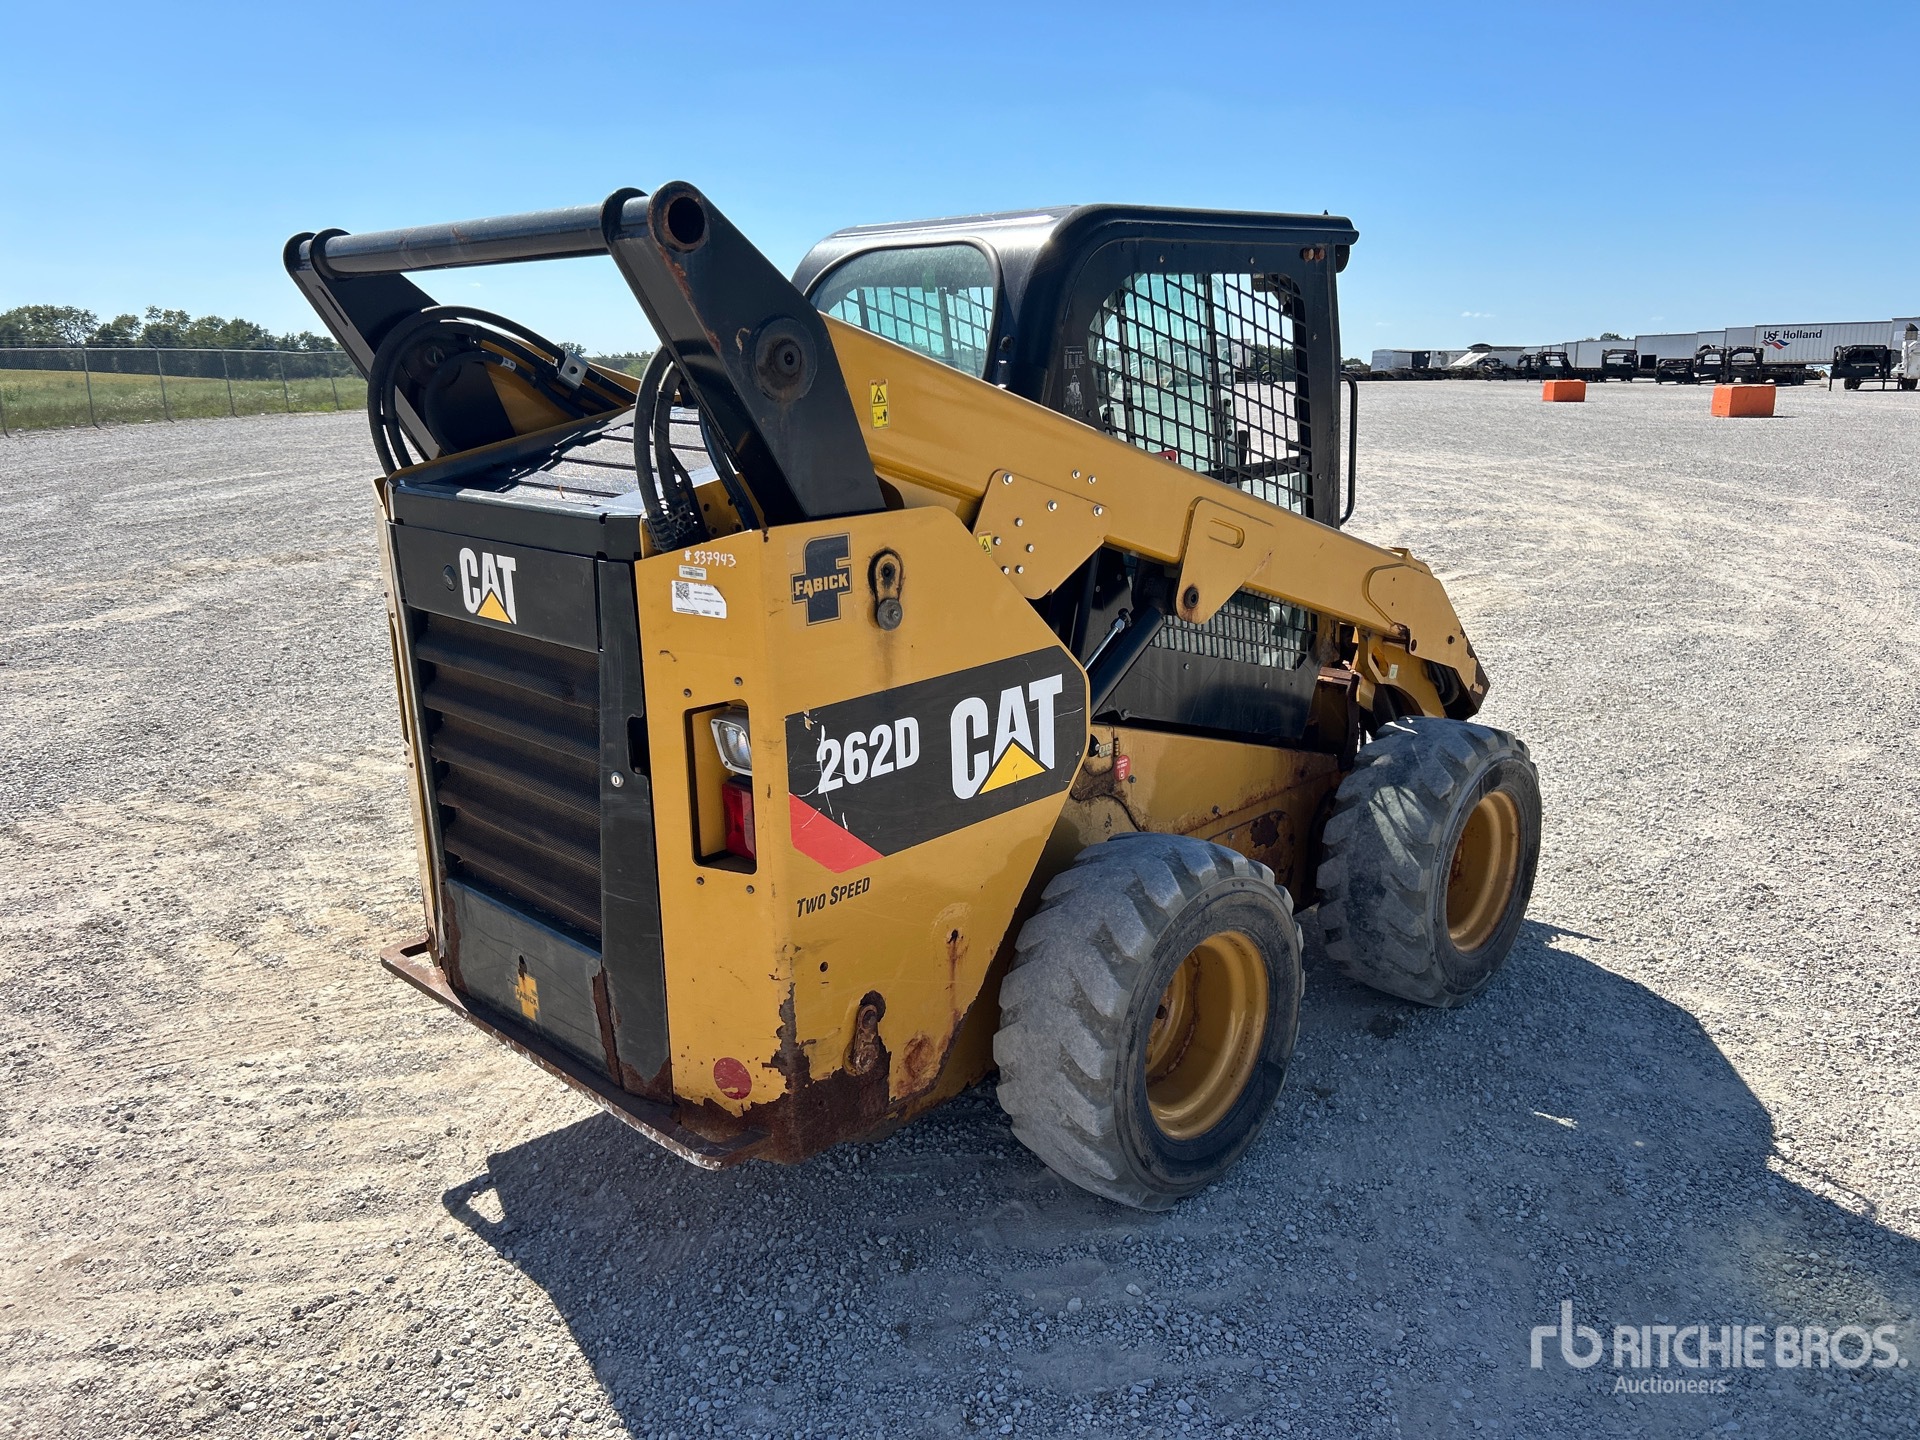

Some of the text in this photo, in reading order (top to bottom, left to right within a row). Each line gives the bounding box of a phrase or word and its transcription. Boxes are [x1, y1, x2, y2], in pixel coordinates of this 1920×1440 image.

[1763, 329, 1823, 341] USF Holland
[459, 547, 517, 625] CAT
[794, 573, 849, 599] FABICK
[816, 673, 1063, 800] 262D CAT
